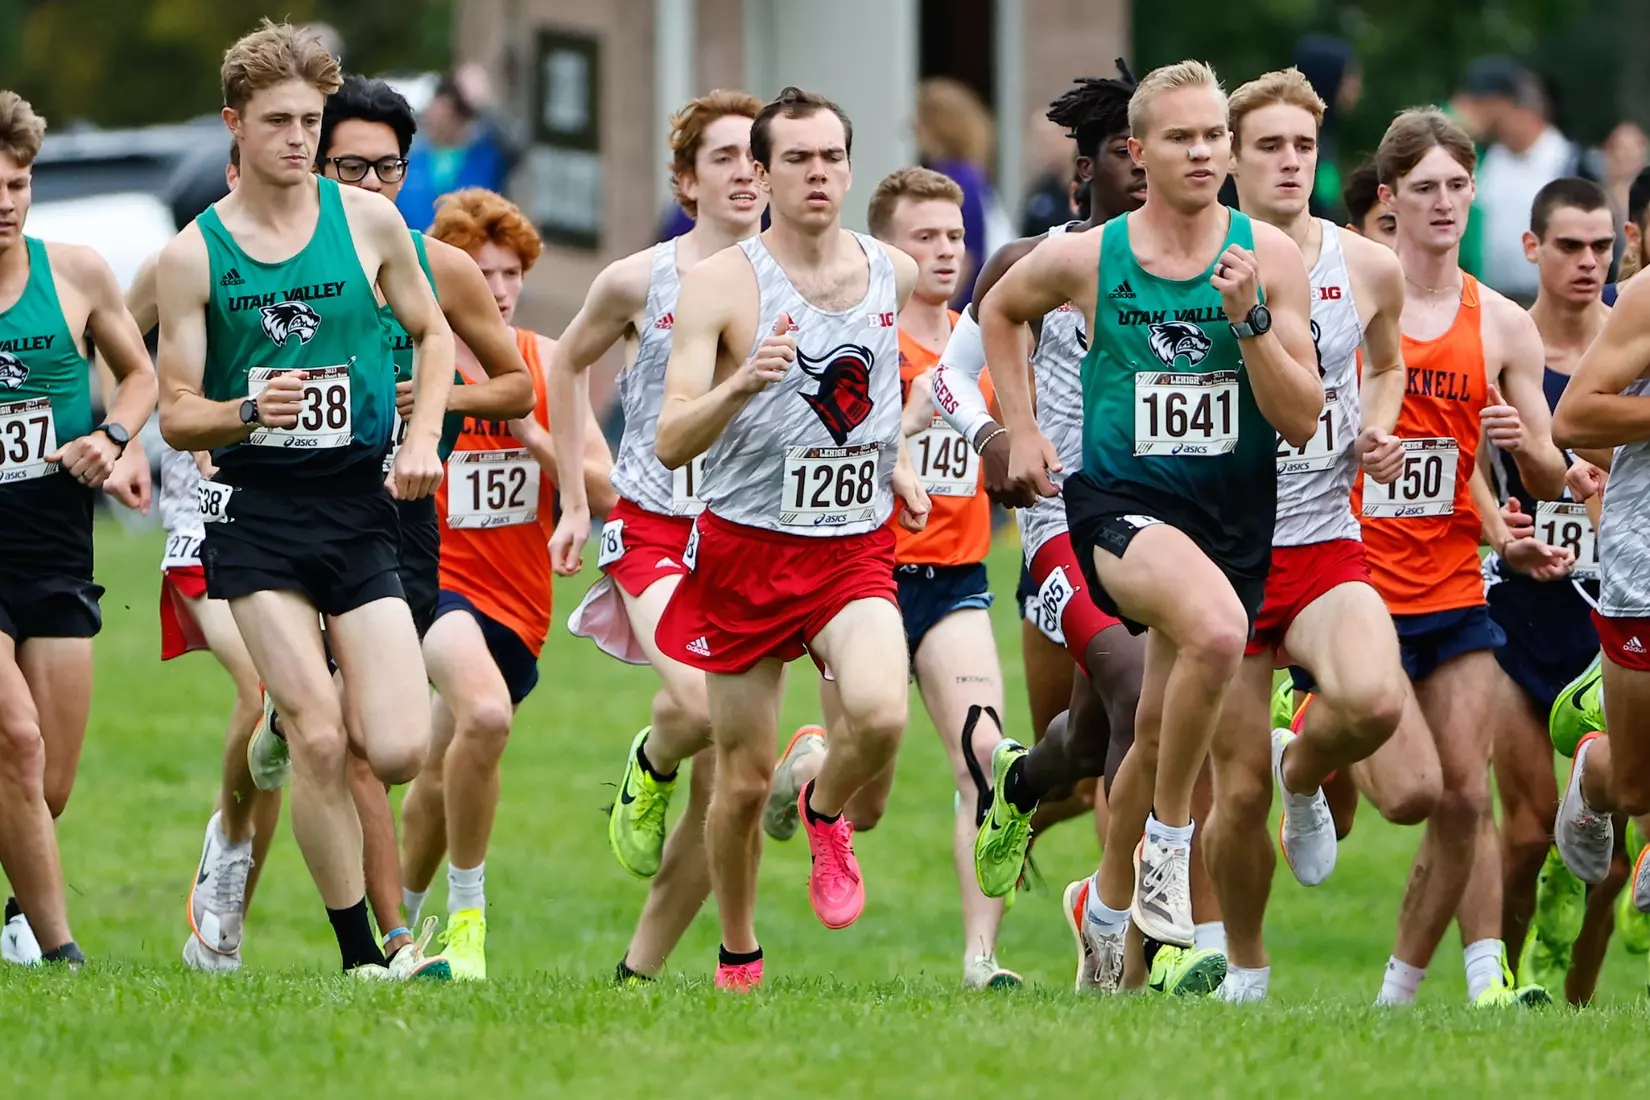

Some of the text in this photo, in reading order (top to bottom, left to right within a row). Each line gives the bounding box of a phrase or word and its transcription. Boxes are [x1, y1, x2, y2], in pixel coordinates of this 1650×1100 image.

[220, 278, 246, 286] adidas
[228, 281, 346, 312] UTAH VALLEY
[1109, 291, 1137, 299] adidas
[1118, 306, 1229, 326] UTAH VALLE
[1170, 375, 1200, 385] LEHIGH
[1405, 367, 1470, 402] KNELL
[1142, 390, 1231, 437] 1641
[295, 438, 318, 448] asics
[819, 448, 848, 457] LEHIGH
[1183, 445, 1208, 454] asics
[918, 436, 968, 479] 149
[1287, 462, 1310, 471] asics
[5, 470, 27, 481] asics
[466, 467, 527, 511] 152
[791, 460, 875, 508] 1268
[1405, 506, 1425, 515] asics
[825, 514, 848, 523] asics
